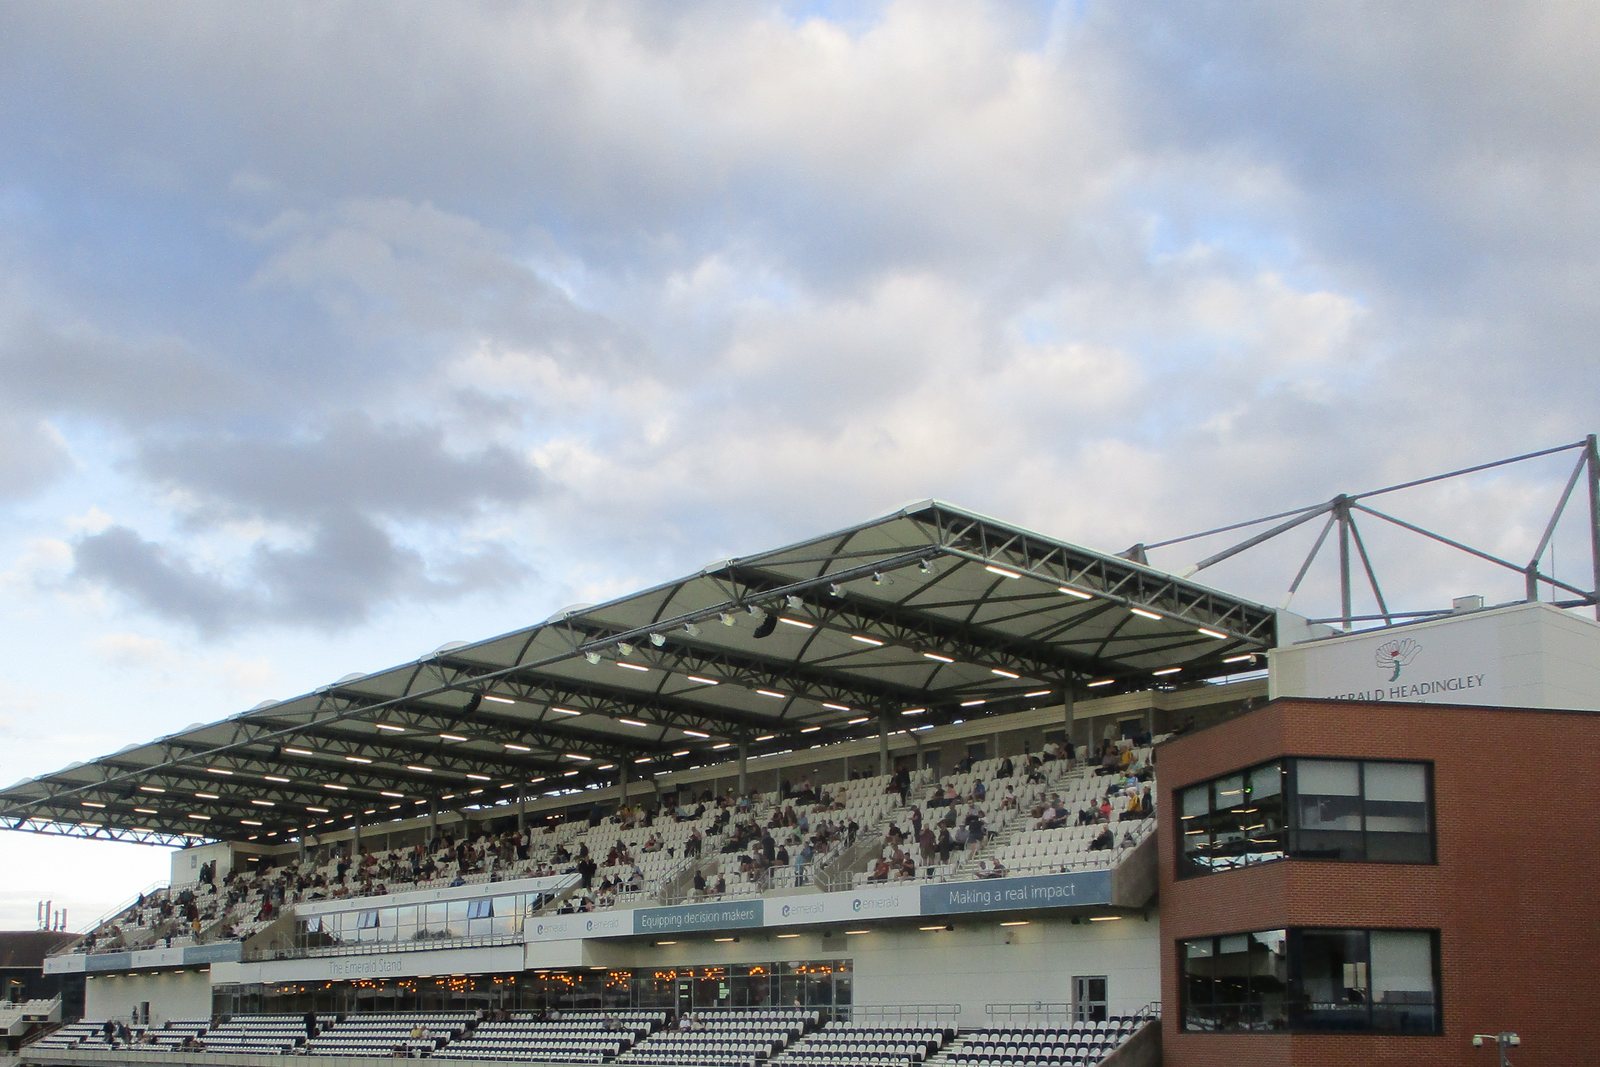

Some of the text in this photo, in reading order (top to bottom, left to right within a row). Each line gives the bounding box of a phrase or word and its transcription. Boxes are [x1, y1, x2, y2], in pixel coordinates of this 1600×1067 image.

[1324, 674, 1486, 701] ERALD HEADINGLEY
[862, 896, 899, 909] emerald
[949, 883, 1075, 905] Making a real impact
[641, 909, 754, 928] Equipping decision makers
[329, 958, 402, 974] The Emerald Stand
